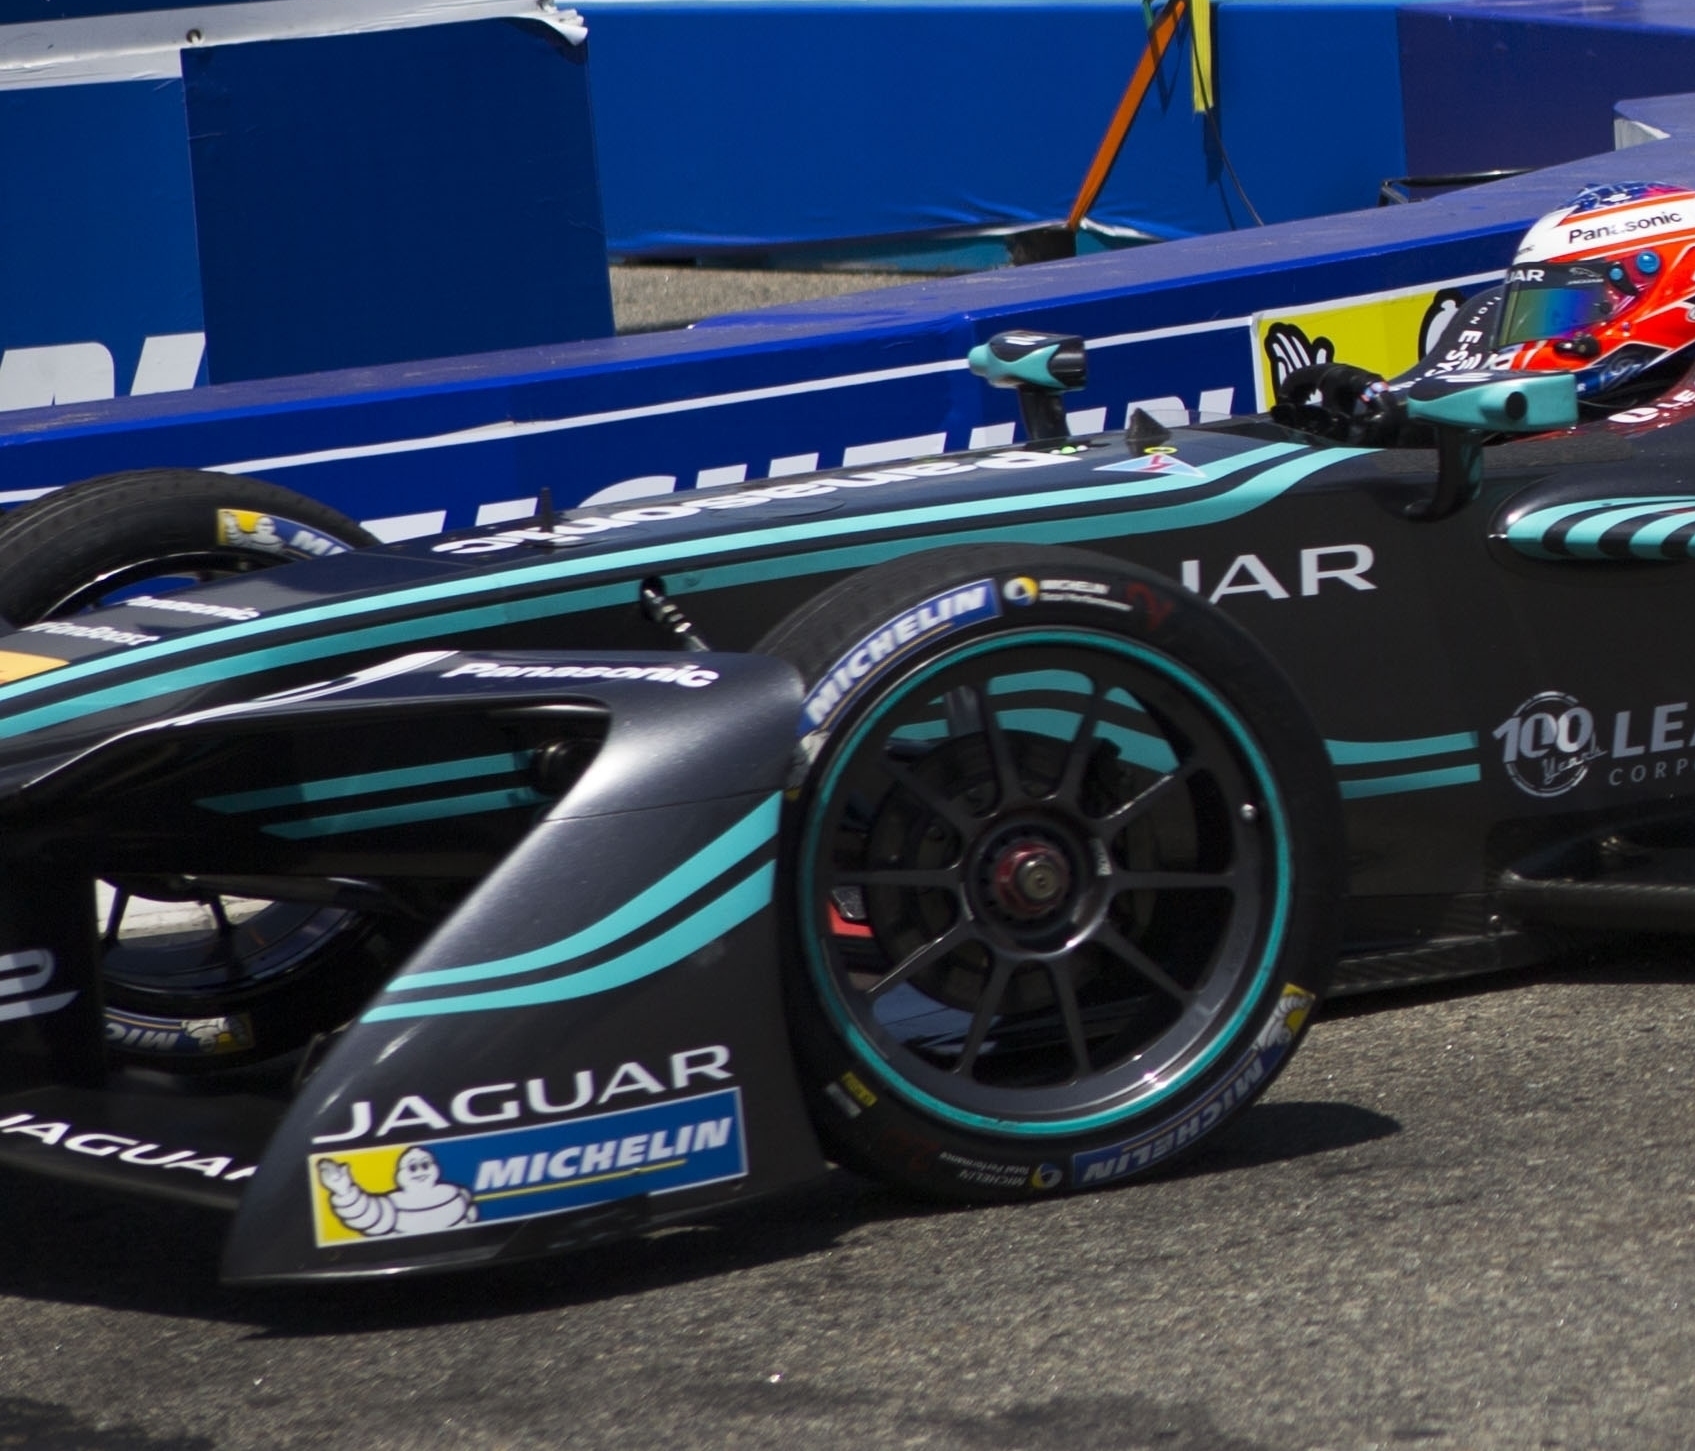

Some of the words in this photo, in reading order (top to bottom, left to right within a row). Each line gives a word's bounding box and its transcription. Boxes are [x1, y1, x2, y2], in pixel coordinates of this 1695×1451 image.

[440, 656, 722, 689] Panasonic
[805, 585, 990, 727] MICHELIN
[1491, 706, 1595, 765] 100
[312, 1043, 735, 1147] JAGUAR
[1083, 1059, 1266, 1184] MICHELIN
[475, 1115, 735, 1193] MICHELIN
